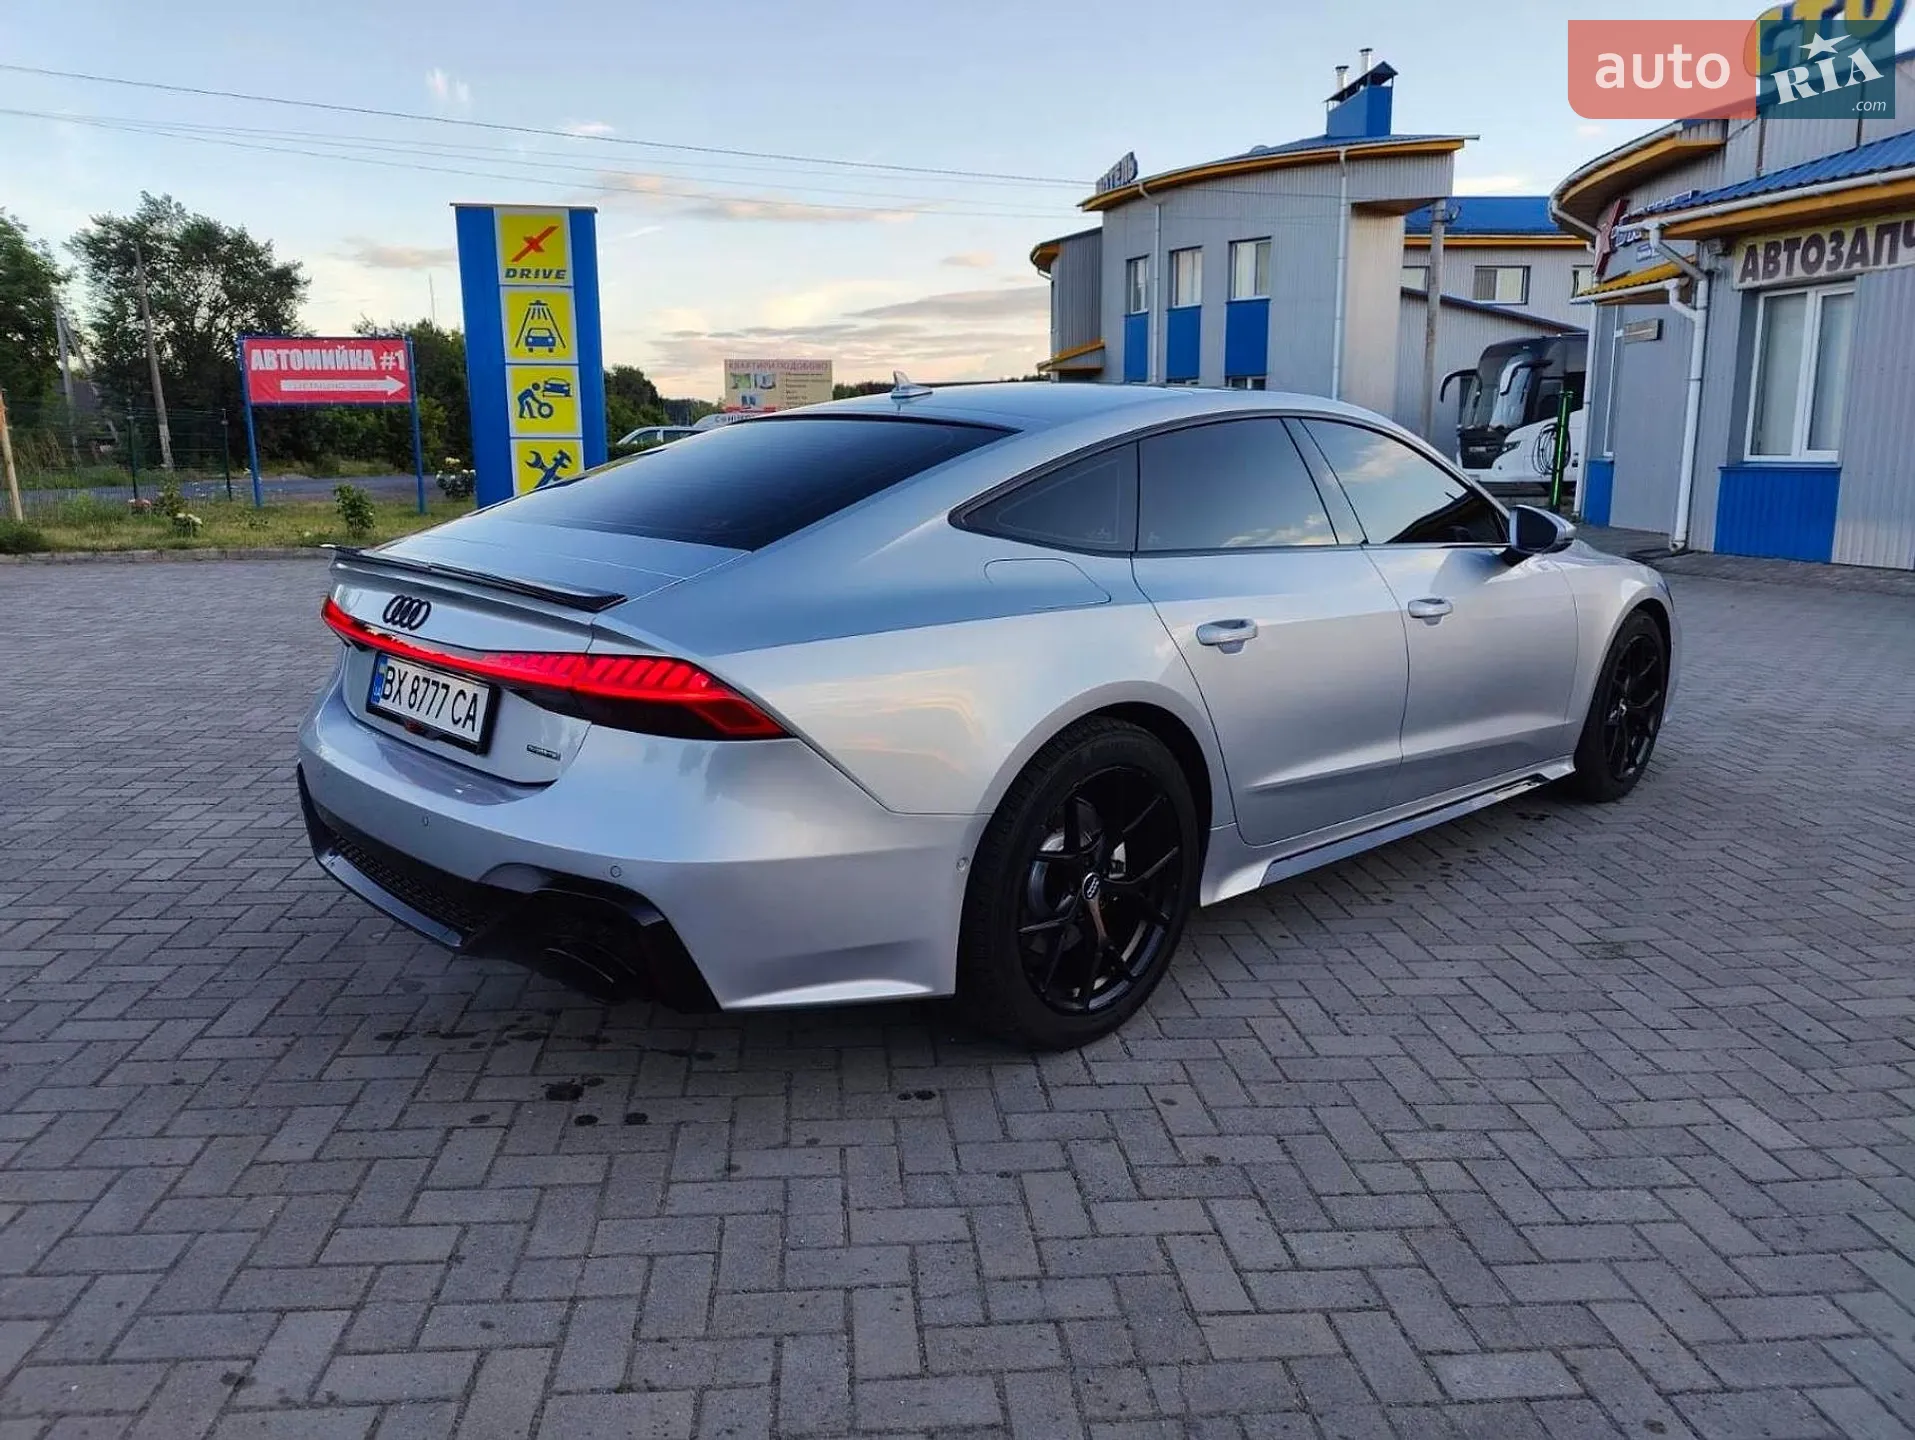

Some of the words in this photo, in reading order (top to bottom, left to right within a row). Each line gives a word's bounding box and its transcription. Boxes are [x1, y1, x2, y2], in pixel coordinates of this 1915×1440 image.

[504, 267, 567, 280] DRIVE
[251, 344, 377, 371] АВТОМИЙКА
[379, 350, 405, 371] #1
[381, 666, 408, 706] BX
[408, 675, 450, 719] 8777
[451, 689, 479, 732] CA
